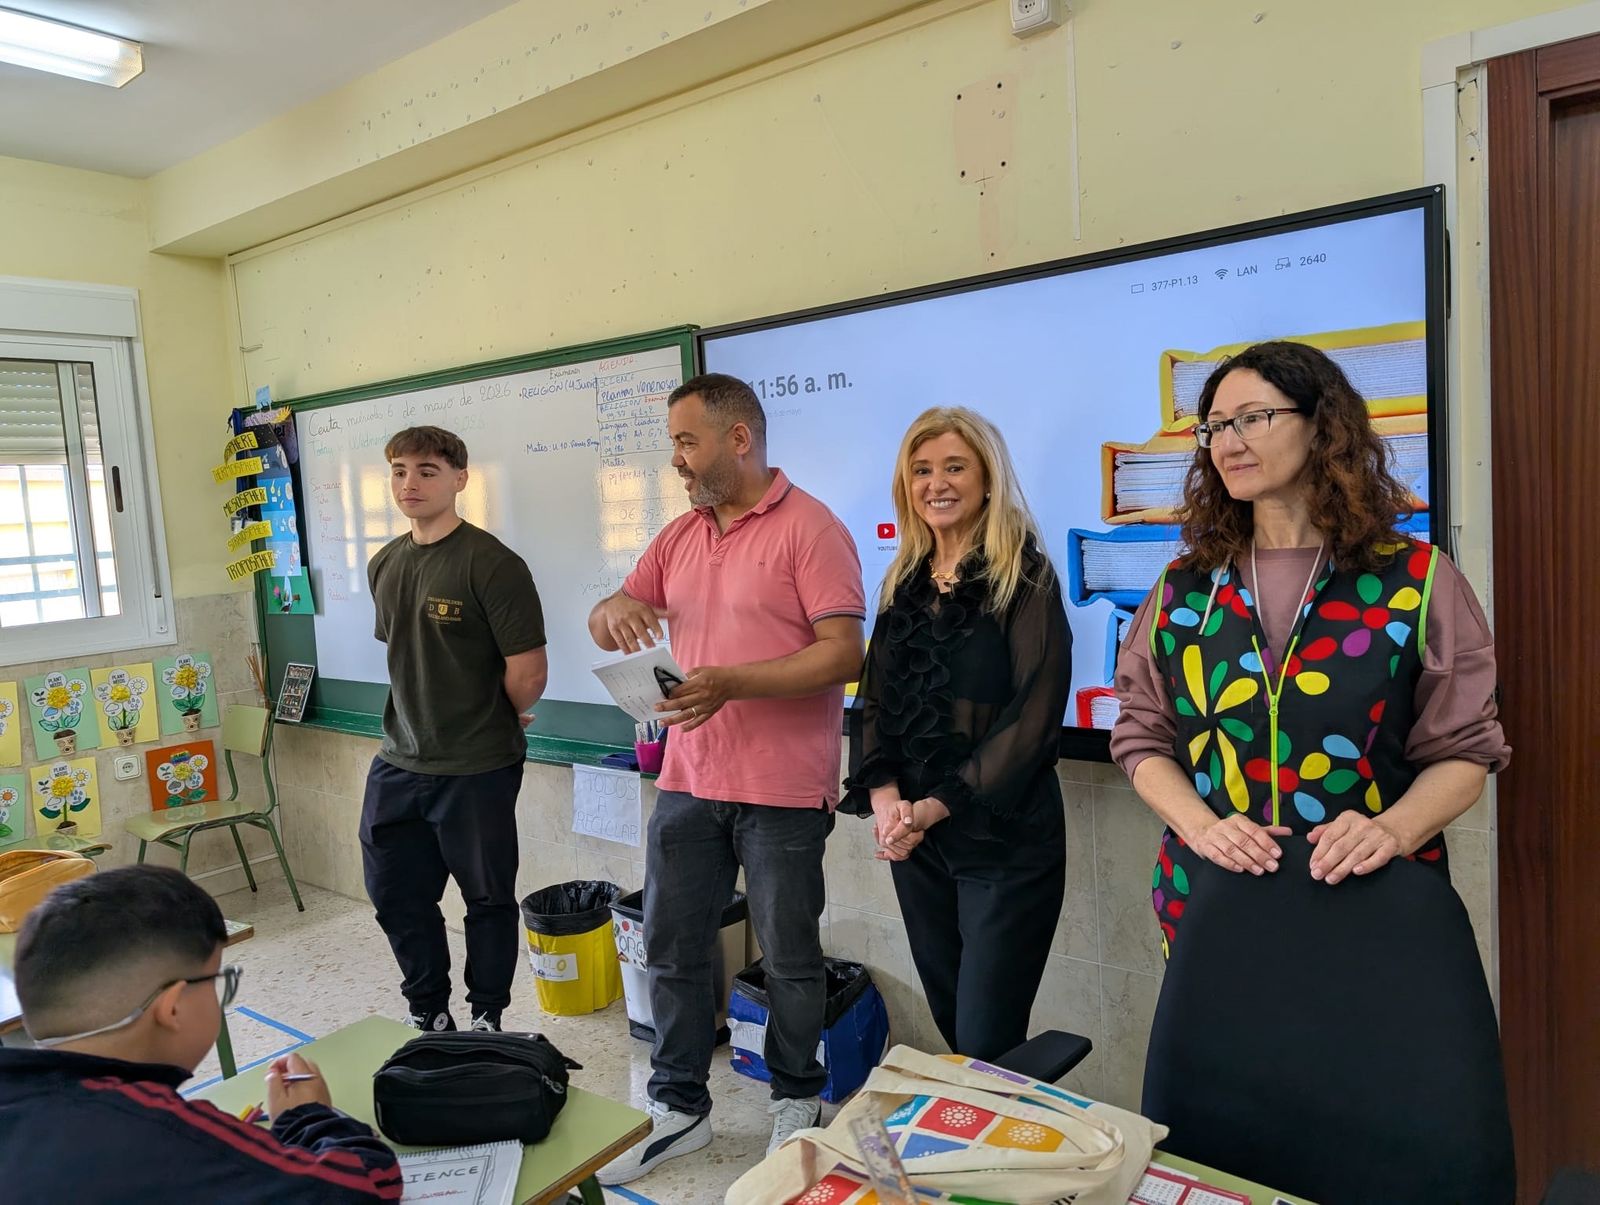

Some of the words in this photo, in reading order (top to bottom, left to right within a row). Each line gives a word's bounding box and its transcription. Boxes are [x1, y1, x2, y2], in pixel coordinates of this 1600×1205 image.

[1299, 252, 1327, 266] 2640
[1236, 265, 1258, 277] LAN
[1151, 275, 1199, 292] 377-P1.13
[827, 371, 853, 391] m.
[402, 399, 416, 417] de
[460, 385, 473, 407] de
[479, 381, 512, 401] 2026
